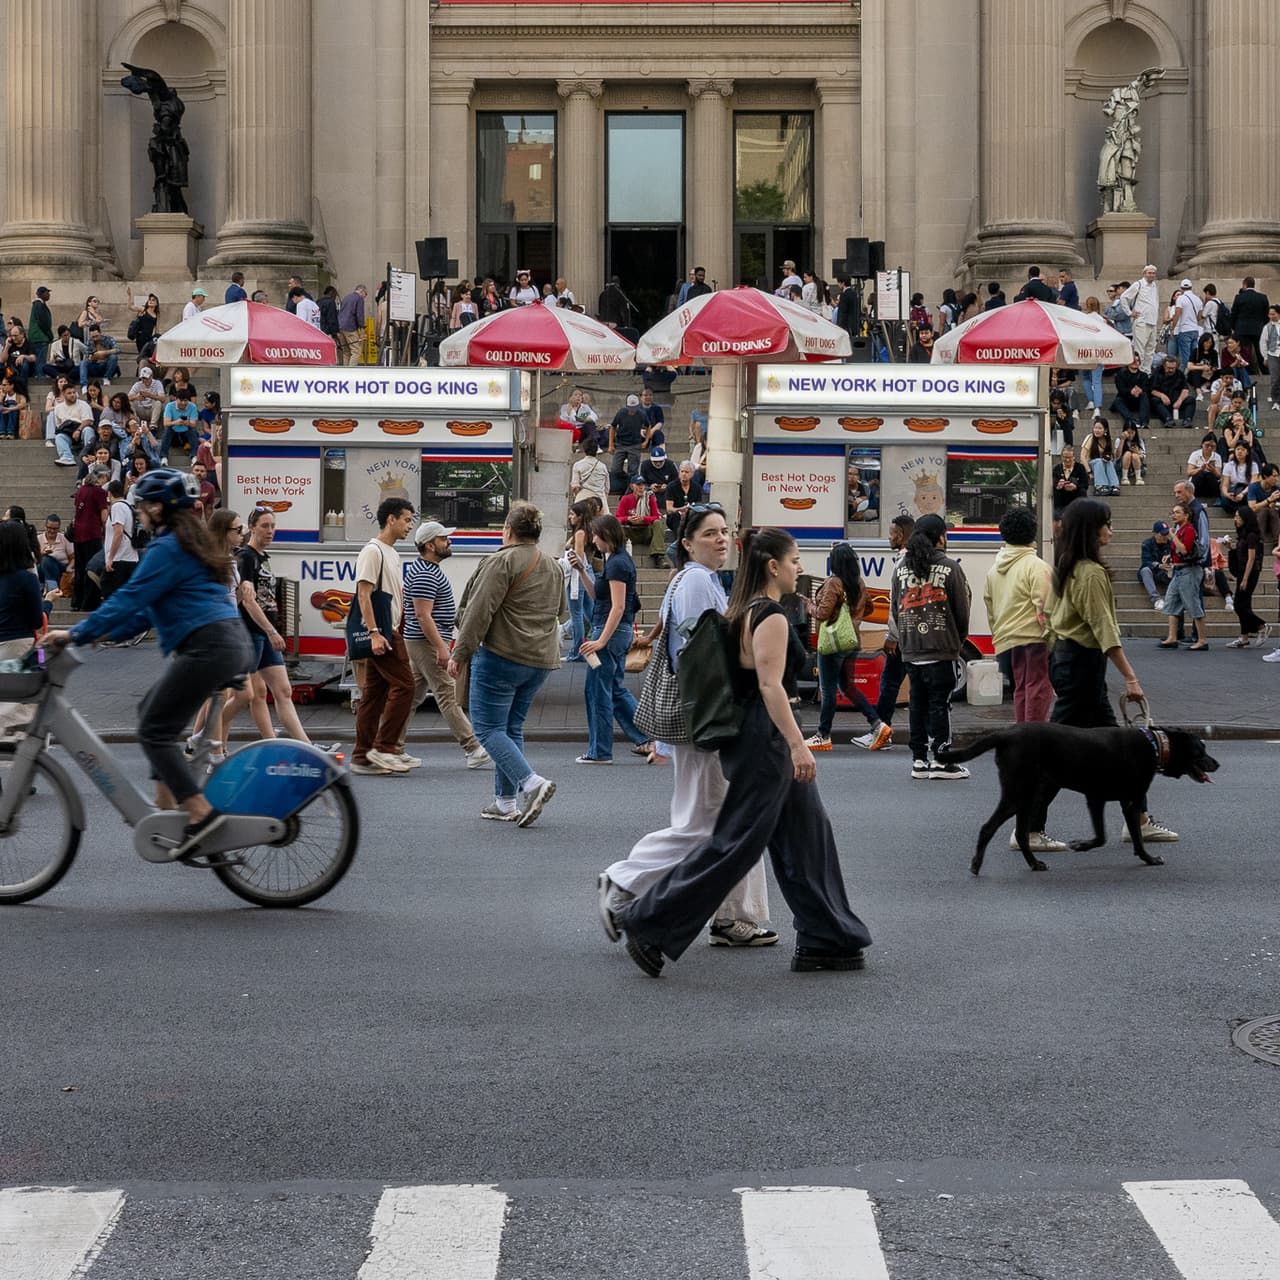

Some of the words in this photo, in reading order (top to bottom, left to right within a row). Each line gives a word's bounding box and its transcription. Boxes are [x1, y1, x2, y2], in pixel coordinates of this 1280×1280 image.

[702, 340, 731, 353] COLD
[731, 337, 772, 352] DRINKS
[805, 336, 819, 347] HOT
[819, 337, 836, 350] DOGS
[180, 347, 197, 358] HOT
[200, 347, 225, 358] DOGS
[265, 347, 290, 359] COLD
[291, 348, 322, 360] DRINKS
[485, 350, 513, 362] COLD
[513, 351, 551, 363] DRINKS
[587, 353, 602, 363] HOT
[603, 354, 622, 364] DOGS
[975, 348, 1002, 360] COLD
[1003, 348, 1041, 360] DRINKS
[1077, 348, 1093, 358] HOT
[1094, 348, 1114, 359] DOGS
[261, 379, 300, 394] NEW
[304, 379, 350, 394] YORK
[354, 380, 390, 395] HOT
[394, 380, 432, 395] DOG
[437, 380, 478, 395] KING
[788, 377, 827, 392] NEW
[831, 377, 877, 392] YORK
[882, 378, 917, 392] HOT
[921, 378, 959, 393] DOG
[964, 379, 1005, 393] KING
[366, 459, 391, 476] NEW
[394, 459, 421, 476] YORK
[900, 456, 925, 473] NEW
[237, 475, 260, 485] Best
[263, 475, 282, 484] Hot
[285, 476, 312, 487] Dogs
[761, 472, 784, 482] Best
[787, 473, 806, 482] Hot
[809, 473, 836, 484] Dogs
[243, 486, 253, 495] in
[255, 486, 279, 496] New
[281, 487, 305, 496] York
[767, 483, 777, 493] in
[780, 484, 803, 493] New
[806, 484, 830, 494] York
[301, 560, 357, 581] NEW
